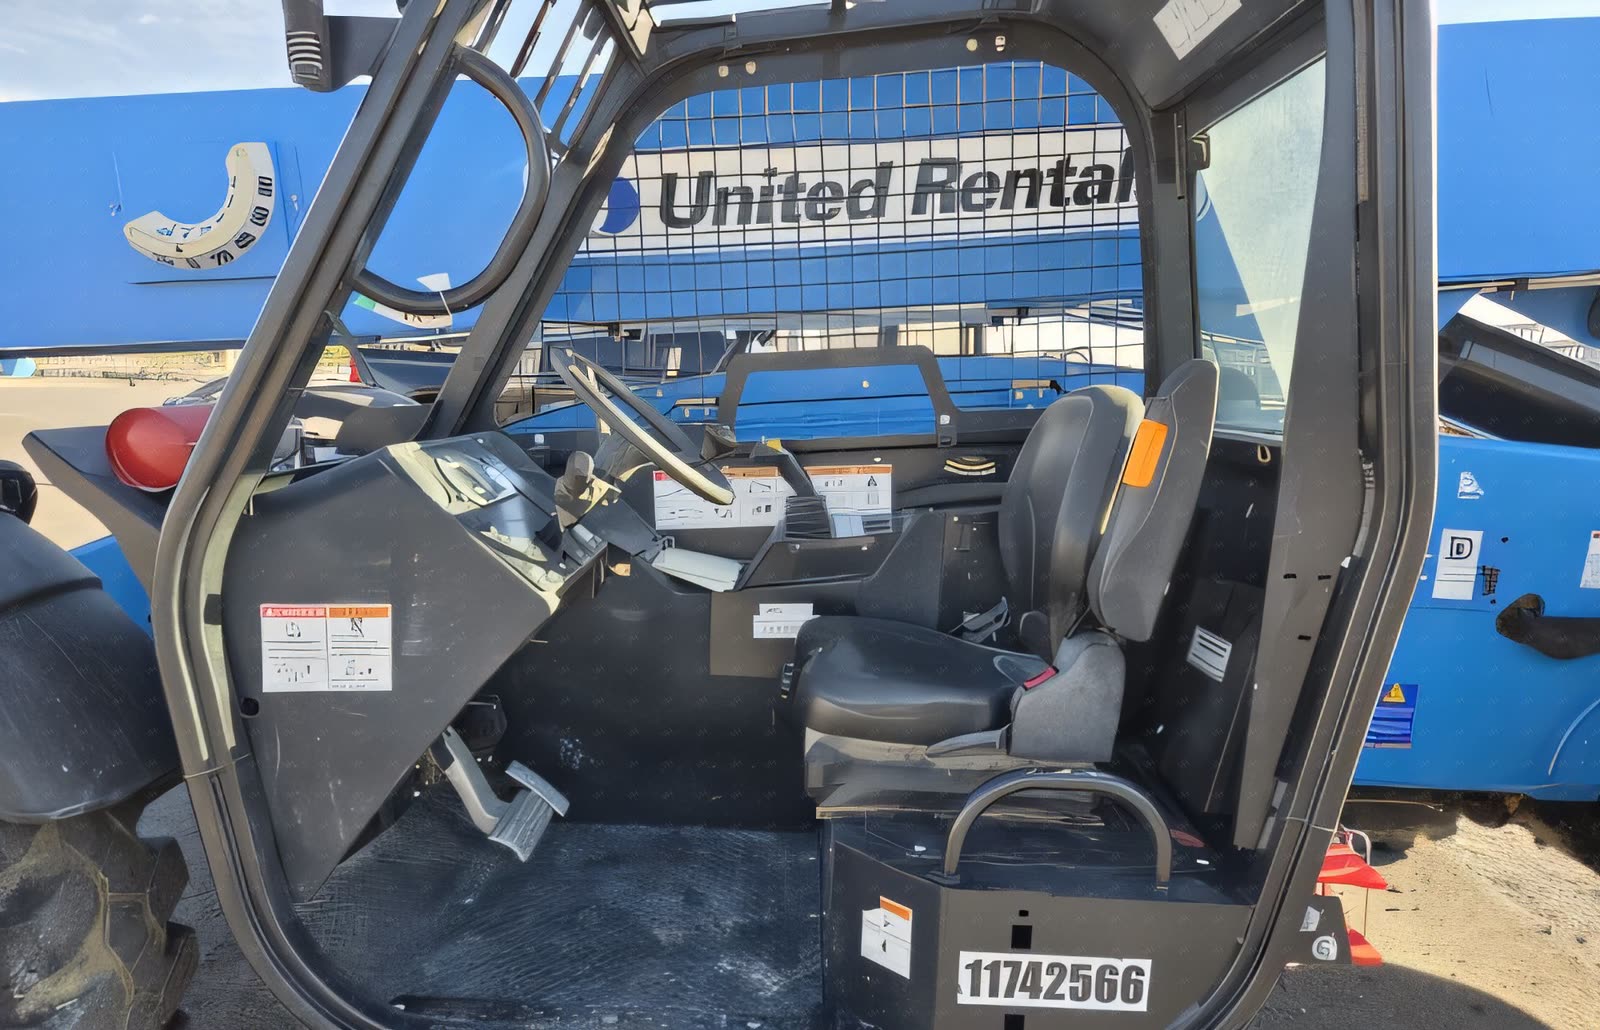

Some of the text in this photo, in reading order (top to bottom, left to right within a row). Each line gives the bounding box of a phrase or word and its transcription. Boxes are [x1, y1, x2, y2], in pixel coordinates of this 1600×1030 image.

[660, 147, 1138, 228] United Rental
[965, 959, 1145, 1004] 11742566
